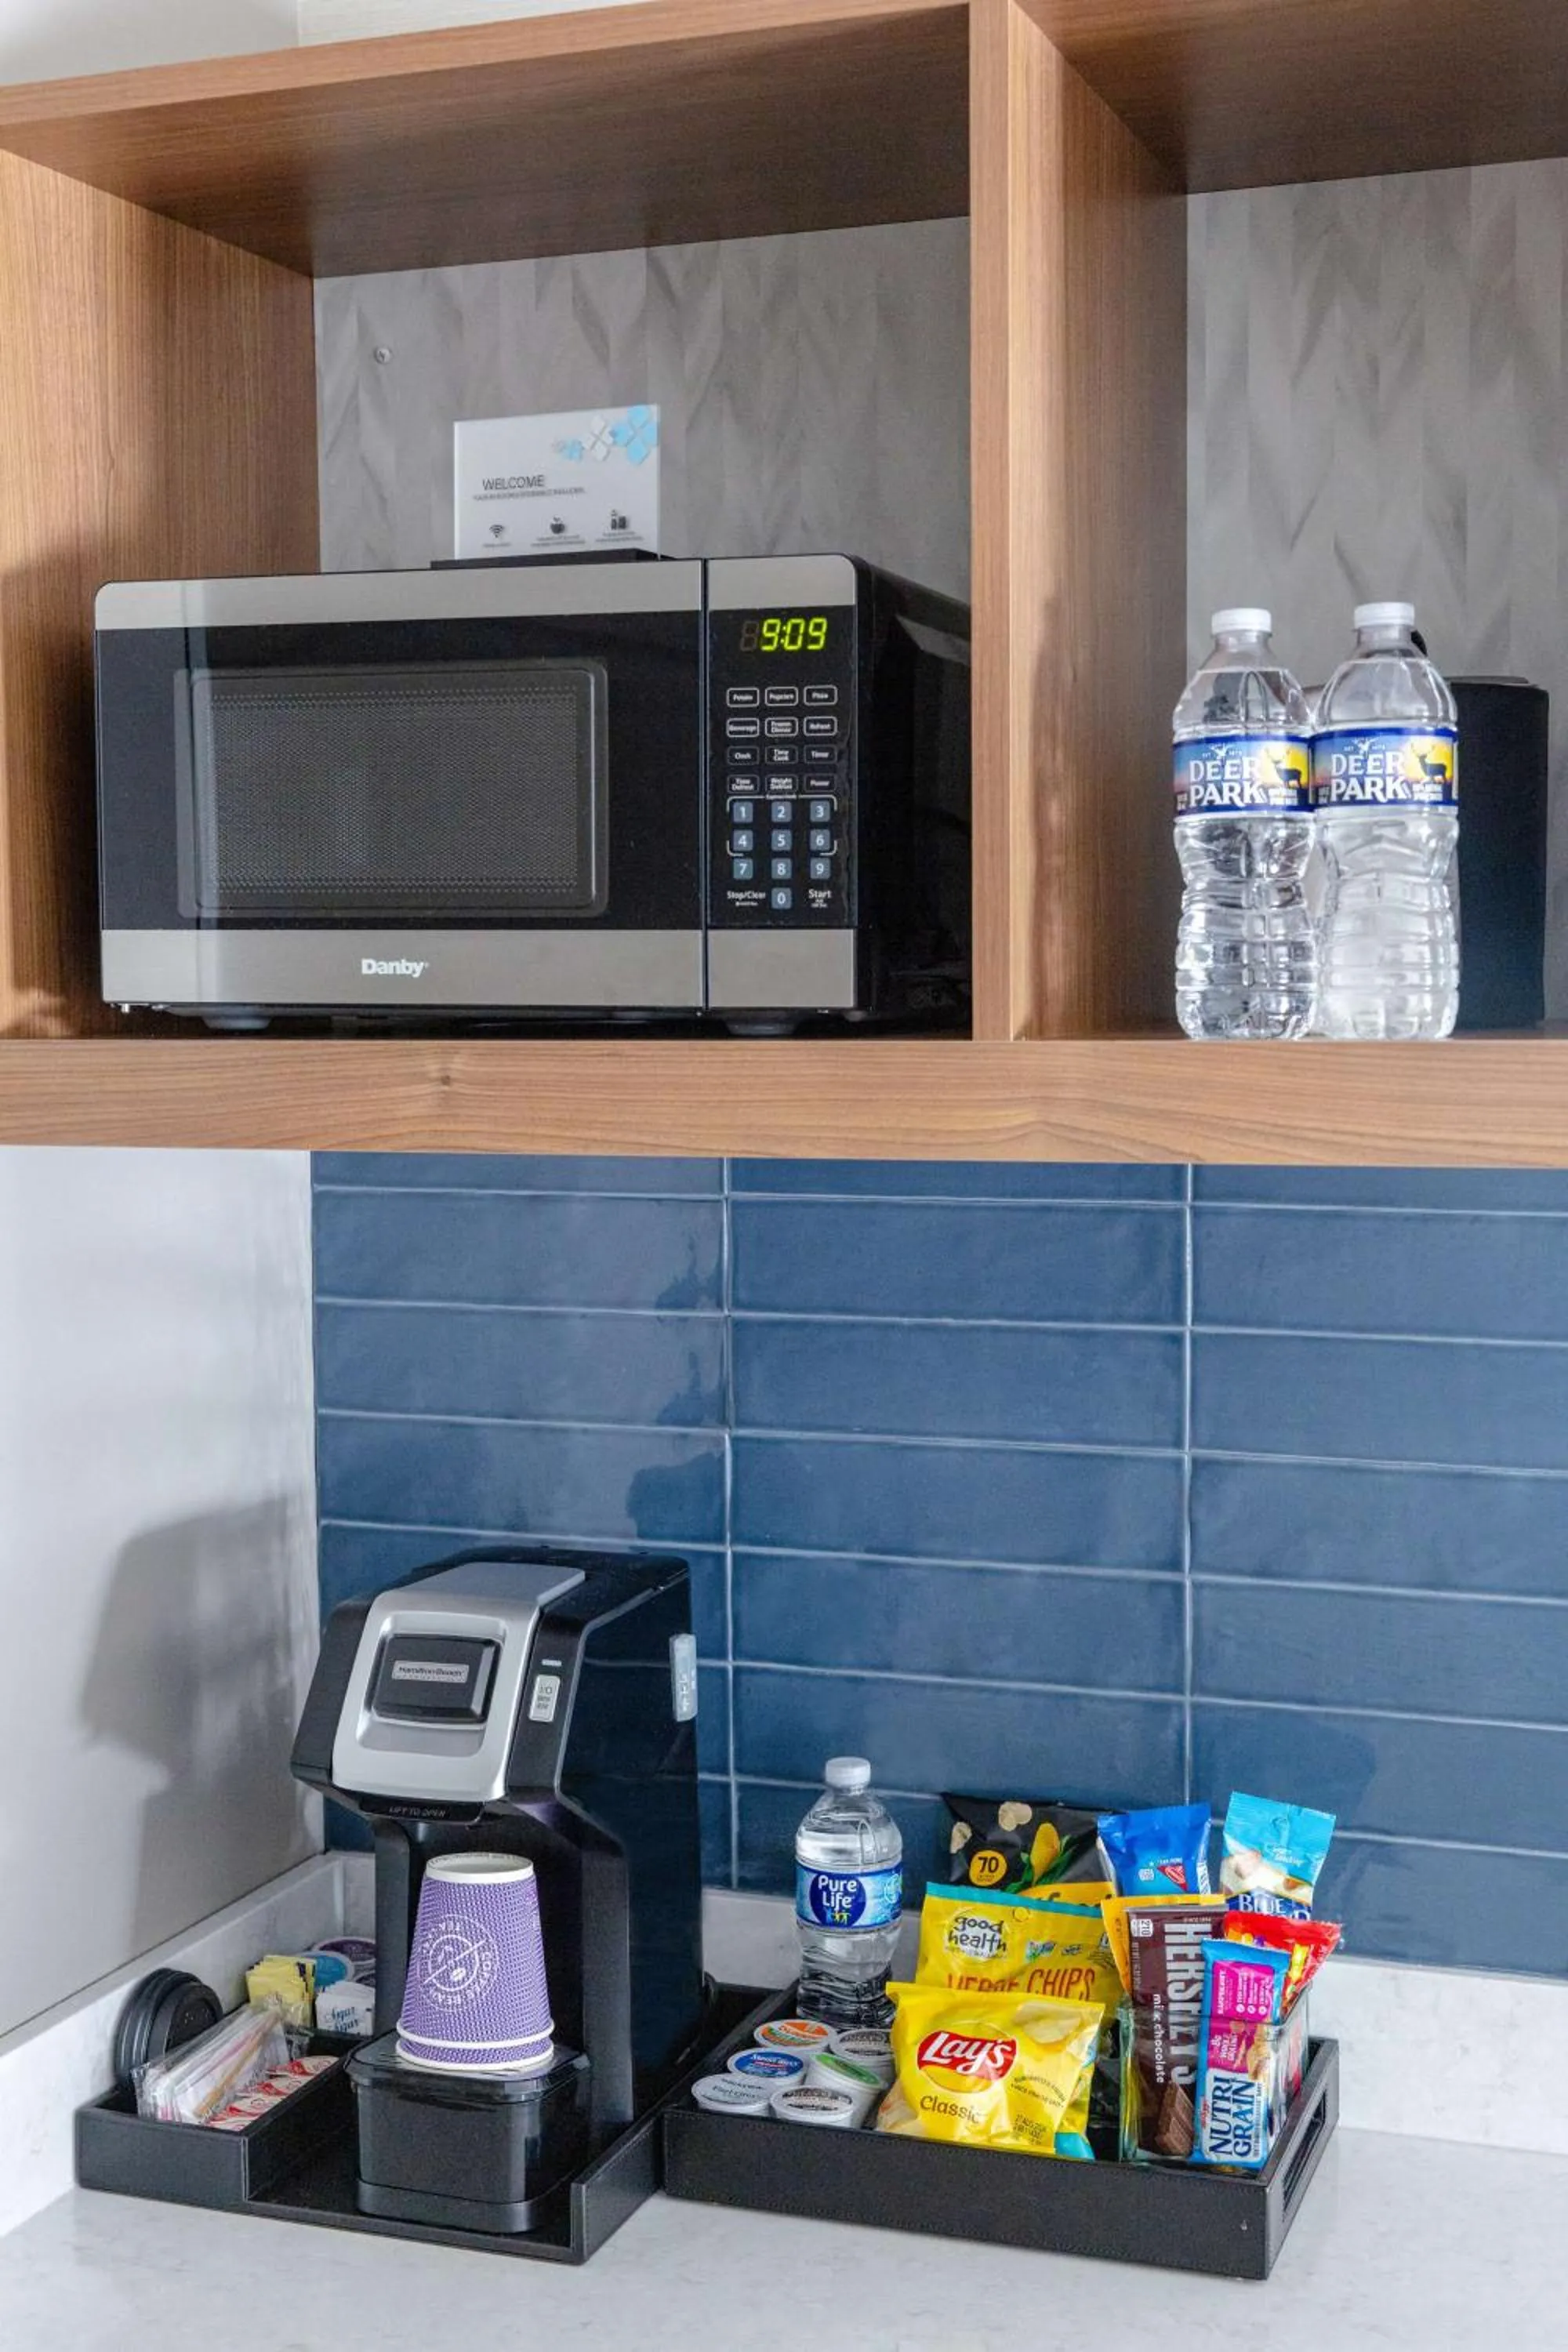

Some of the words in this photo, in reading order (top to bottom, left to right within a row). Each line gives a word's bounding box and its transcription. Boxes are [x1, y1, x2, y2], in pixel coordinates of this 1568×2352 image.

[482, 474, 545, 491] WELCOME
[761, 617, 828, 651] 9:09
[1189, 756, 1262, 782] DEER
[1330, 750, 1406, 776] DEER
[1189, 780, 1264, 808] PARK
[1330, 775, 1408, 804] PARK
[739, 806, 746, 818] 1
[777, 805, 786, 818] 2
[816, 805, 824, 818] 3
[738, 834, 747, 847] 4
[777, 834, 786, 847] 5
[816, 834, 824, 846] 6
[739, 862, 747, 875] 7
[777, 862, 786, 876] 8
[816, 862, 824, 875] 9
[727, 890, 765, 900] Stop/Clear
[777, 891, 786, 904] 0
[808, 888, 832, 898] Start
[361, 957, 424, 978] Danby
[978, 1856, 999, 1874] 70
[818, 1875, 857, 1892] Pure
[822, 1891, 852, 1914] Life
[953, 1915, 1005, 1934] good
[1141, 1920, 1151, 1936] 210
[948, 1929, 1007, 1953] health
[1027, 1968, 1095, 2002] CHIPS
[921, 2031, 1012, 2074] Lay's
[1153, 2021, 1167, 2083] chocolate
[920, 2095, 981, 2125] Classic
[1209, 2075, 1233, 2155] NUTRI
[1232, 2078, 1256, 2158] GRAIN
